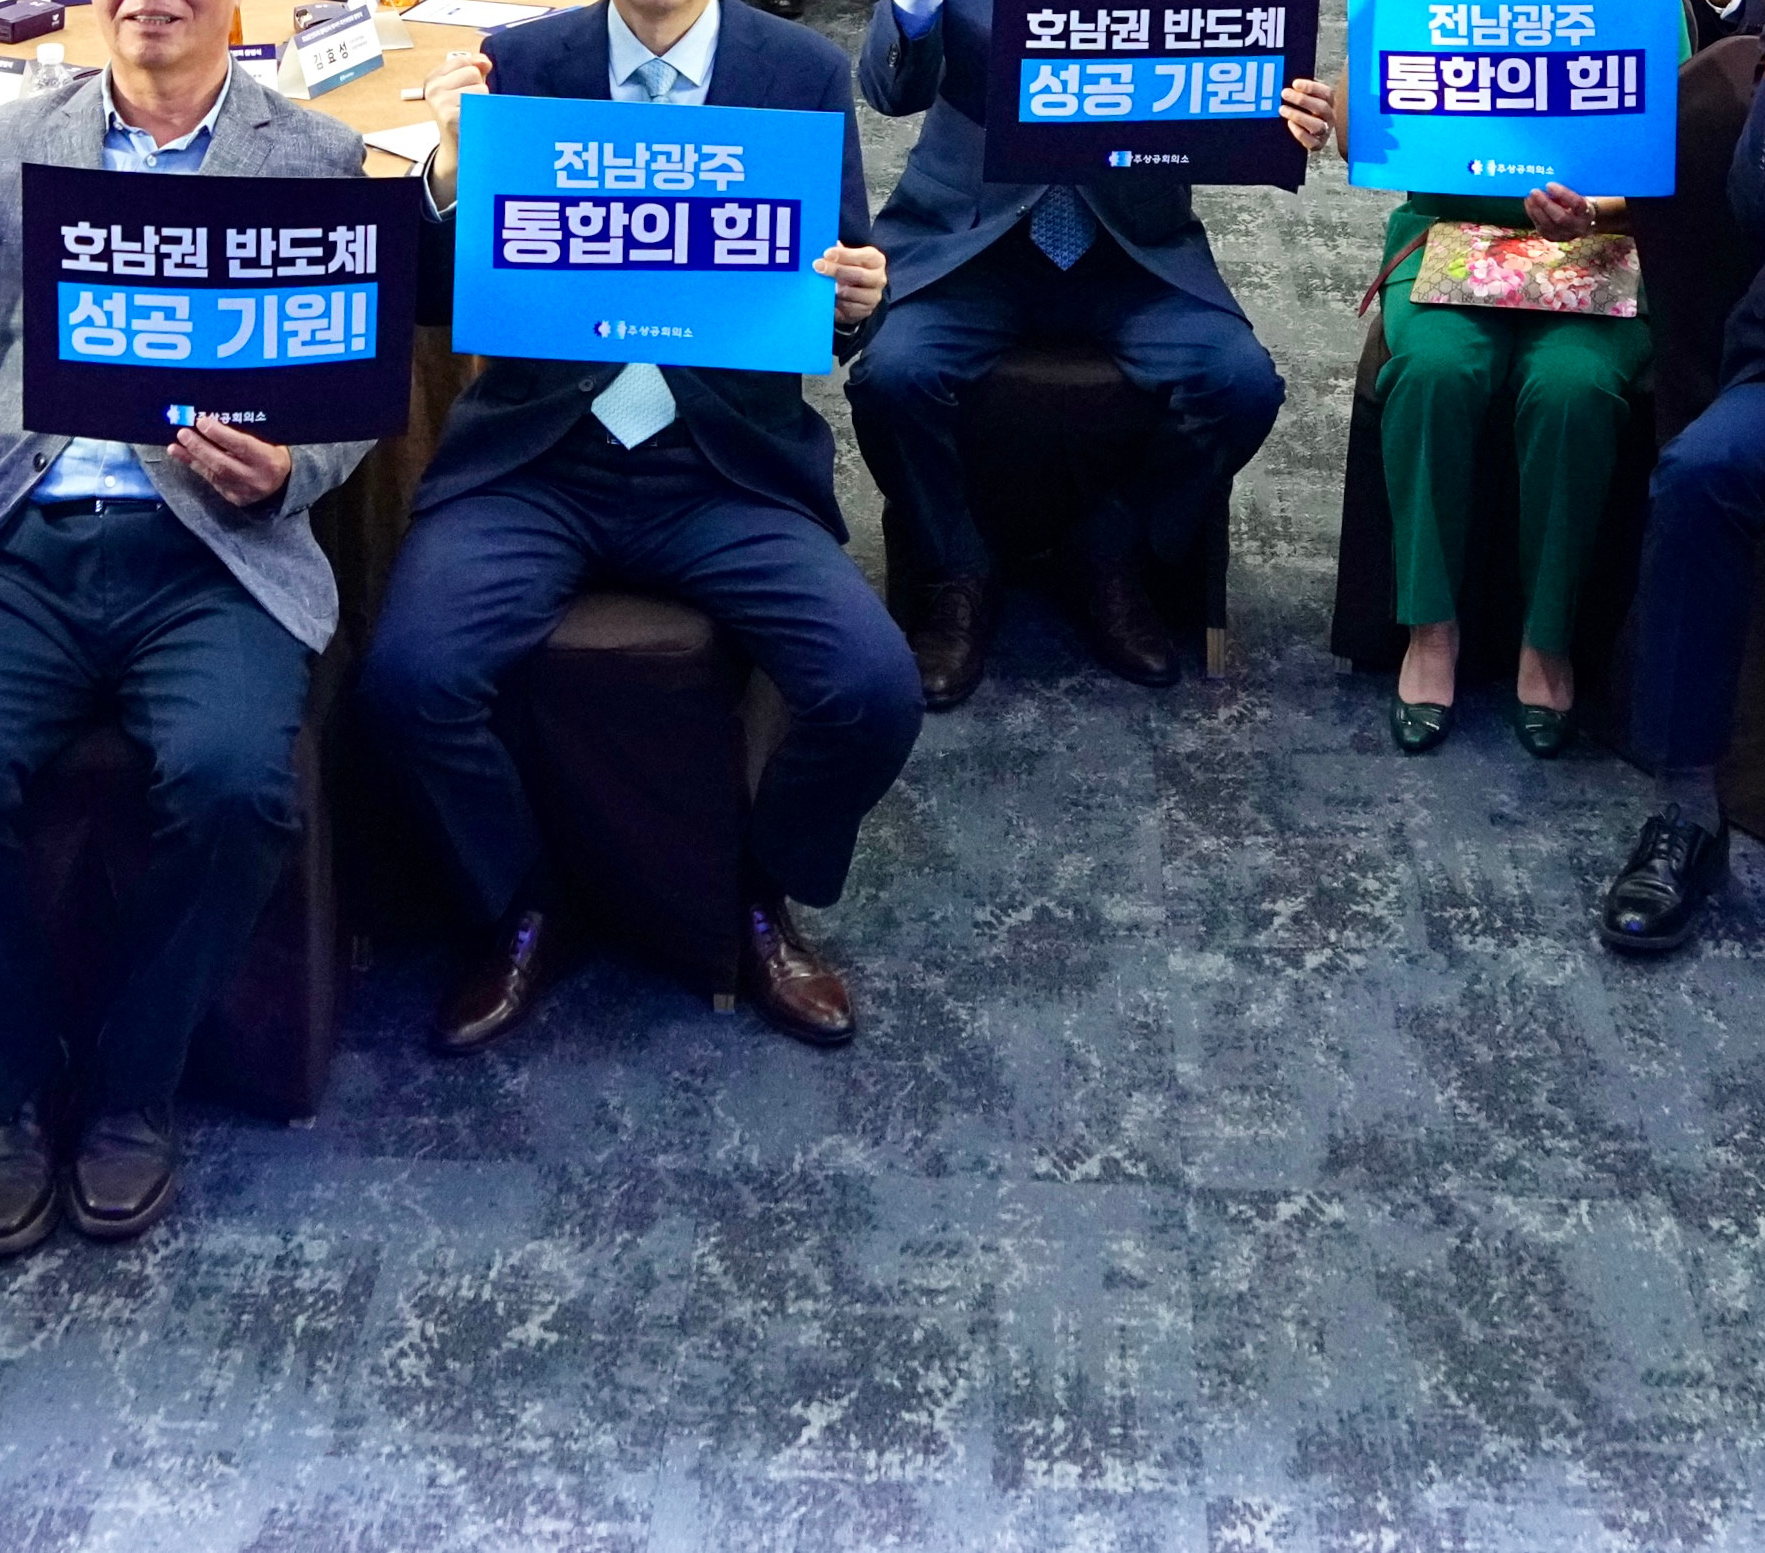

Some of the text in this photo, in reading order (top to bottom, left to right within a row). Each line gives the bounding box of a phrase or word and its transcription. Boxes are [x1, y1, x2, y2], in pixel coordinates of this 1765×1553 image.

[1026, 7, 1285, 49] 호남권 반도체
[1429, 4, 1595, 45] 전남광주
[1030, 62, 1274, 116] 성공 기원!
[1387, 55, 1636, 111] 통합의 힘!
[554, 142, 744, 191] 전남광주
[1121, 151, 1190, 167] 주상공회의소
[1486, 159, 1555, 176] 주상공회의소
[61, 222, 377, 278] 호남권 반도체
[502, 201, 790, 264] 통합의 힘!
[69, 292, 366, 359] 성공 기원!
[616, 320, 694, 339] 주상공회의소
